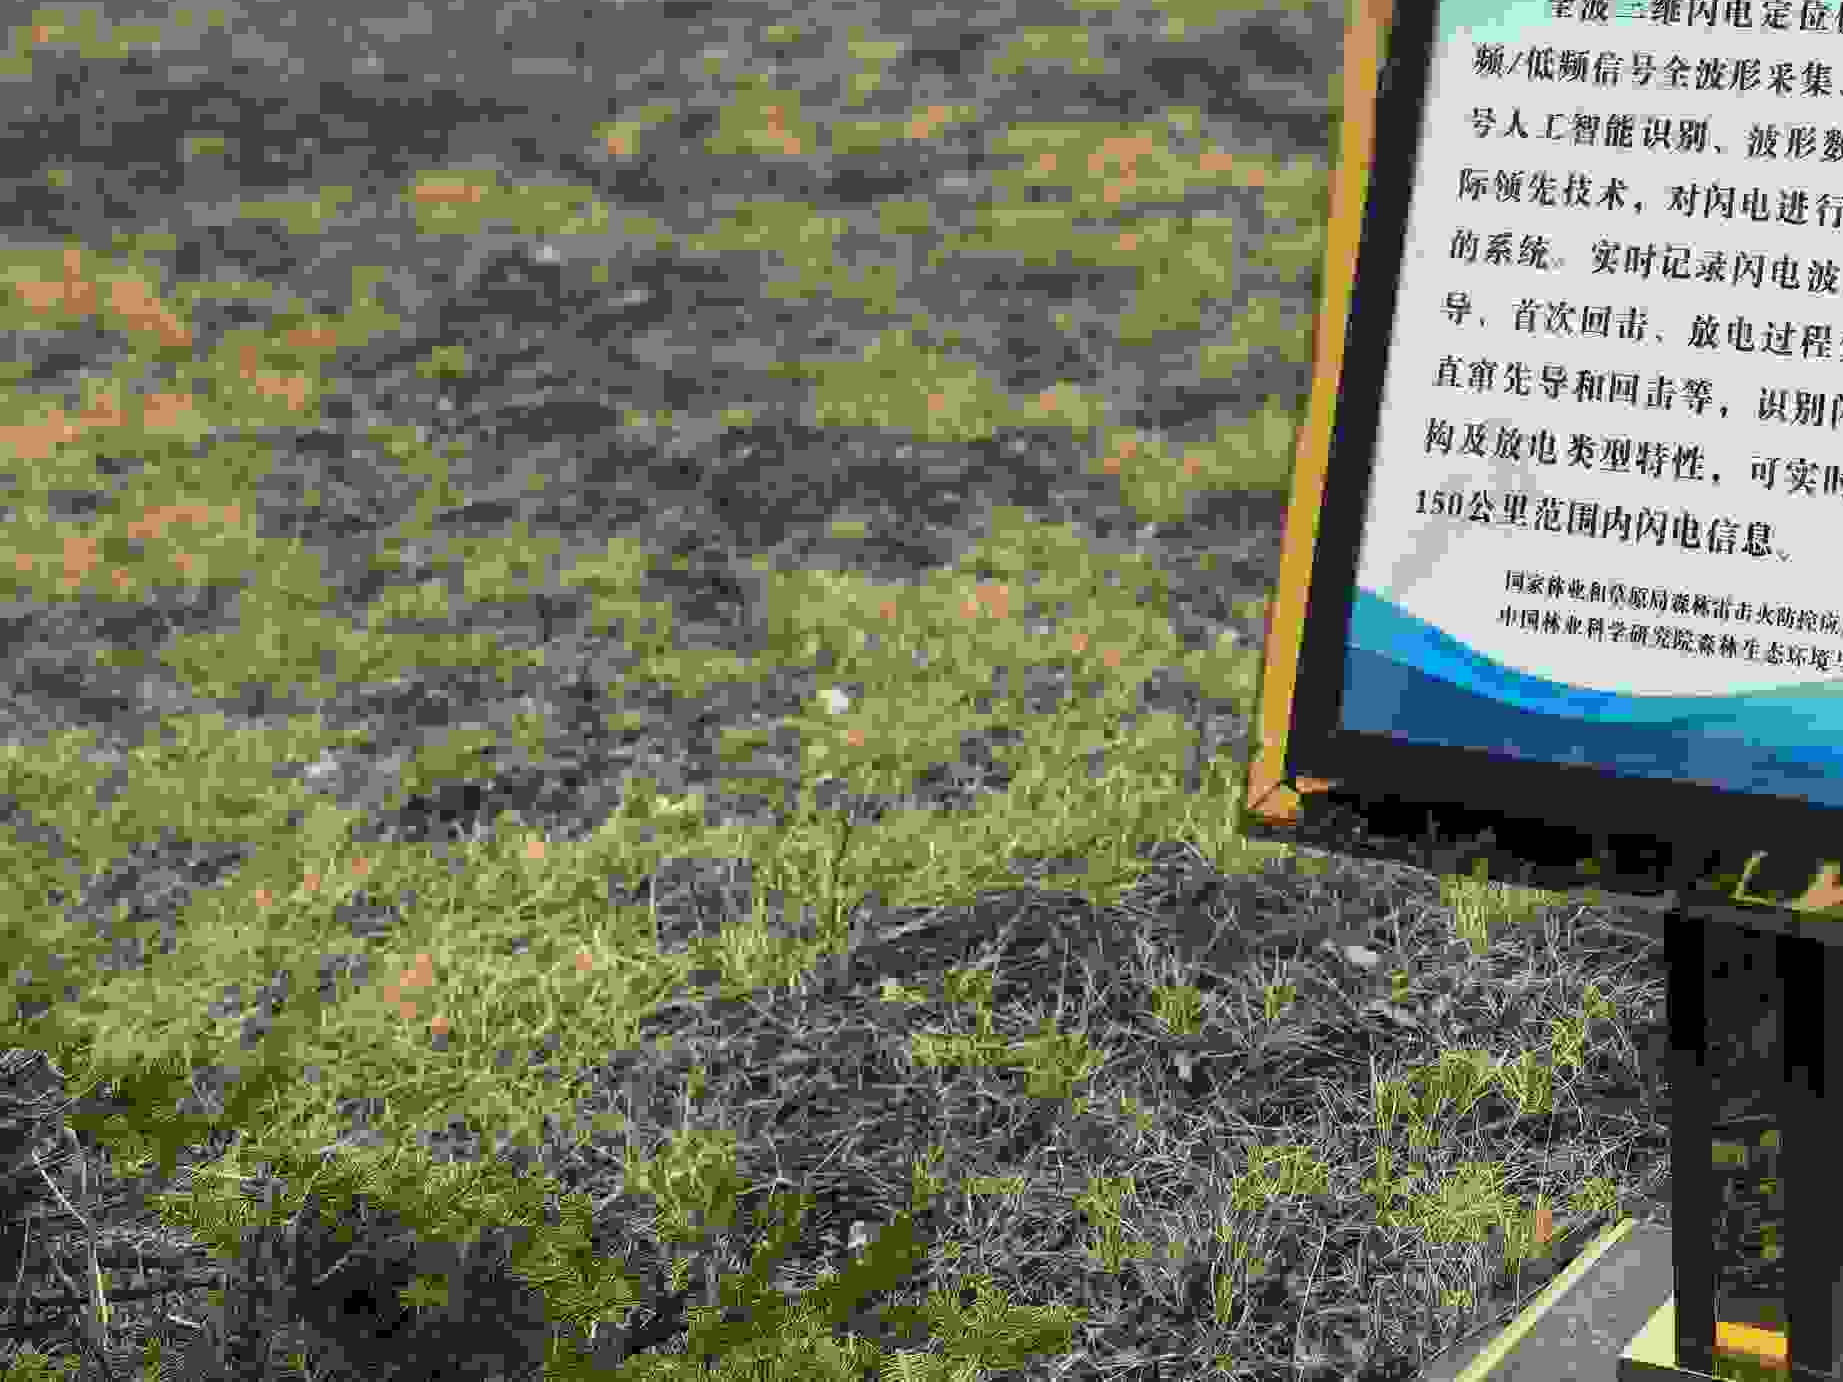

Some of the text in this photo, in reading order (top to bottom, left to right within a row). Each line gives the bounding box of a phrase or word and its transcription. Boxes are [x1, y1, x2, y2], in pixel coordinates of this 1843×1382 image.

[1415, 489, 1791, 561] 150公里范围内闪电信息。
